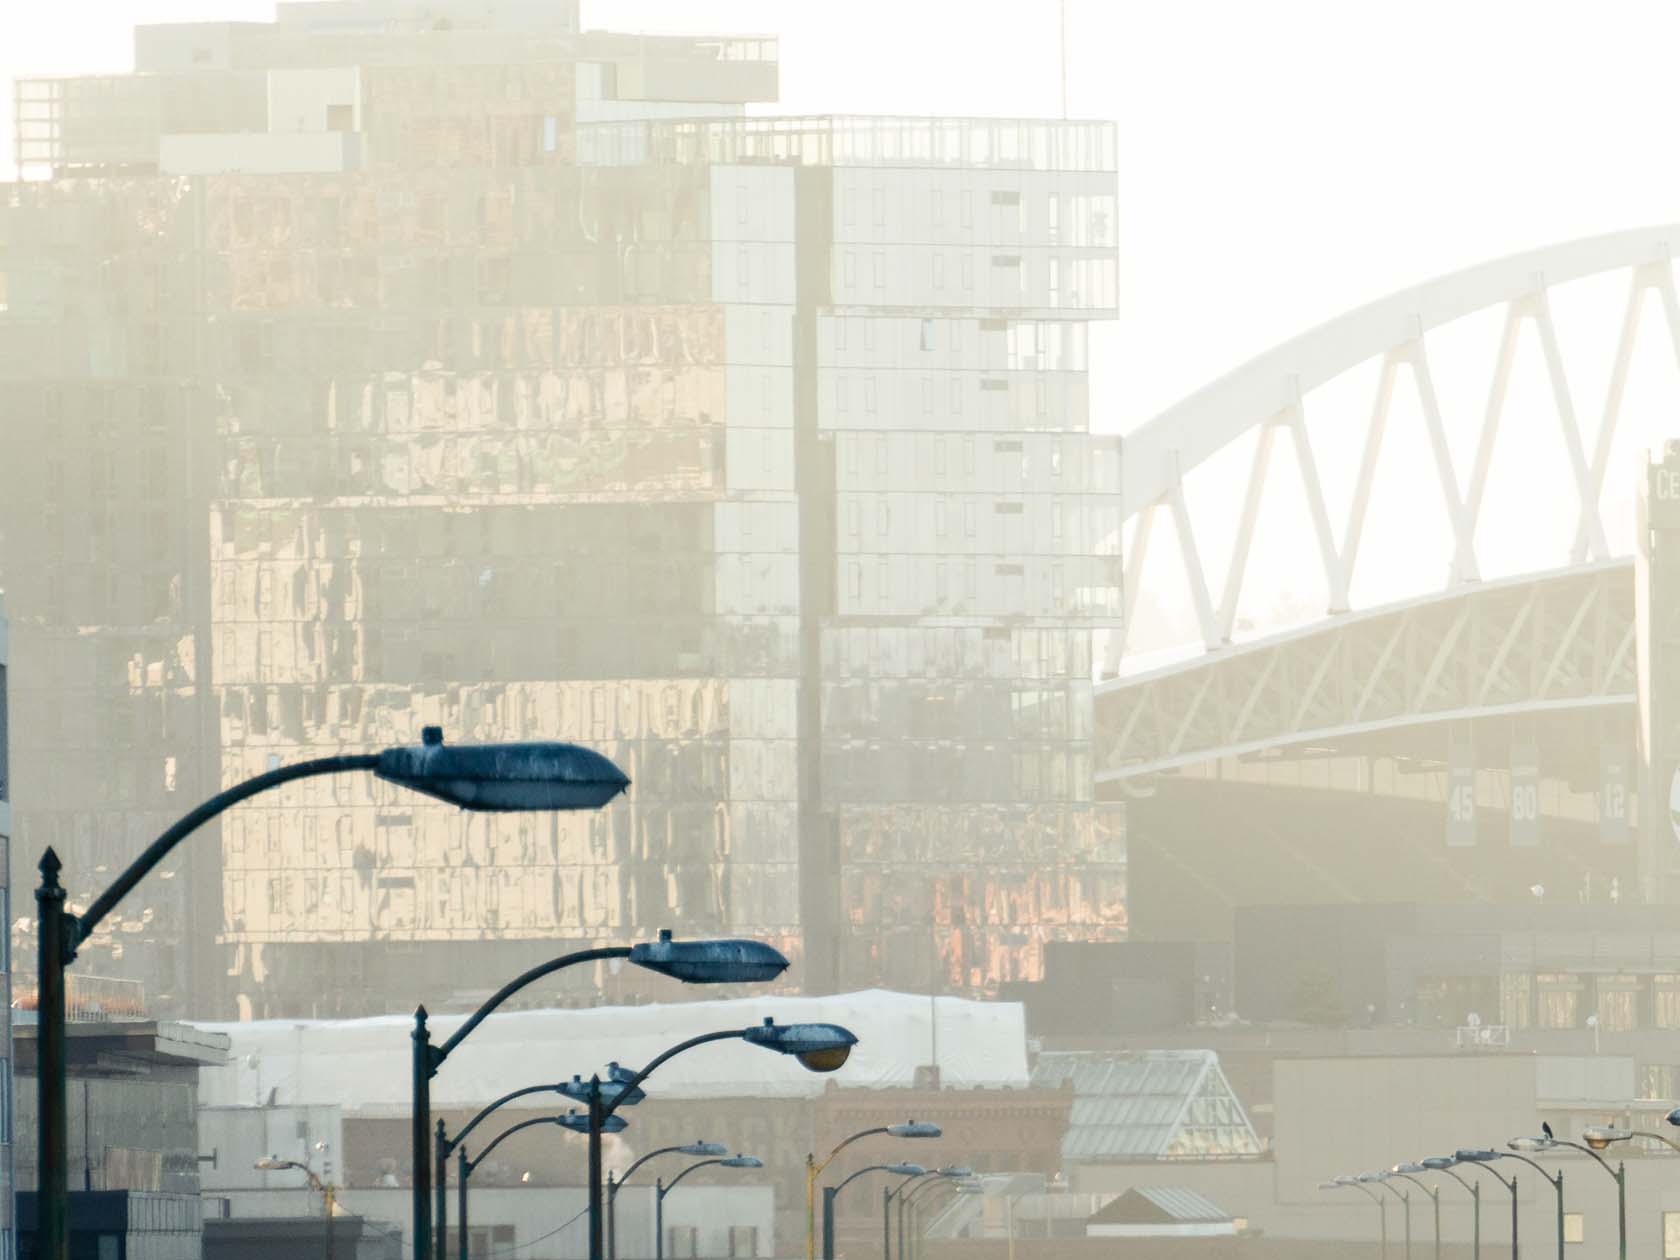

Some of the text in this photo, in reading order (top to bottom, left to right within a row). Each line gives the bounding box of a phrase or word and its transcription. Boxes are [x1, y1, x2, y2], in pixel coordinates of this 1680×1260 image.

[1448, 784, 1473, 822] 45
[1513, 784, 1537, 820] 80
[1605, 783, 1625, 818] 12
